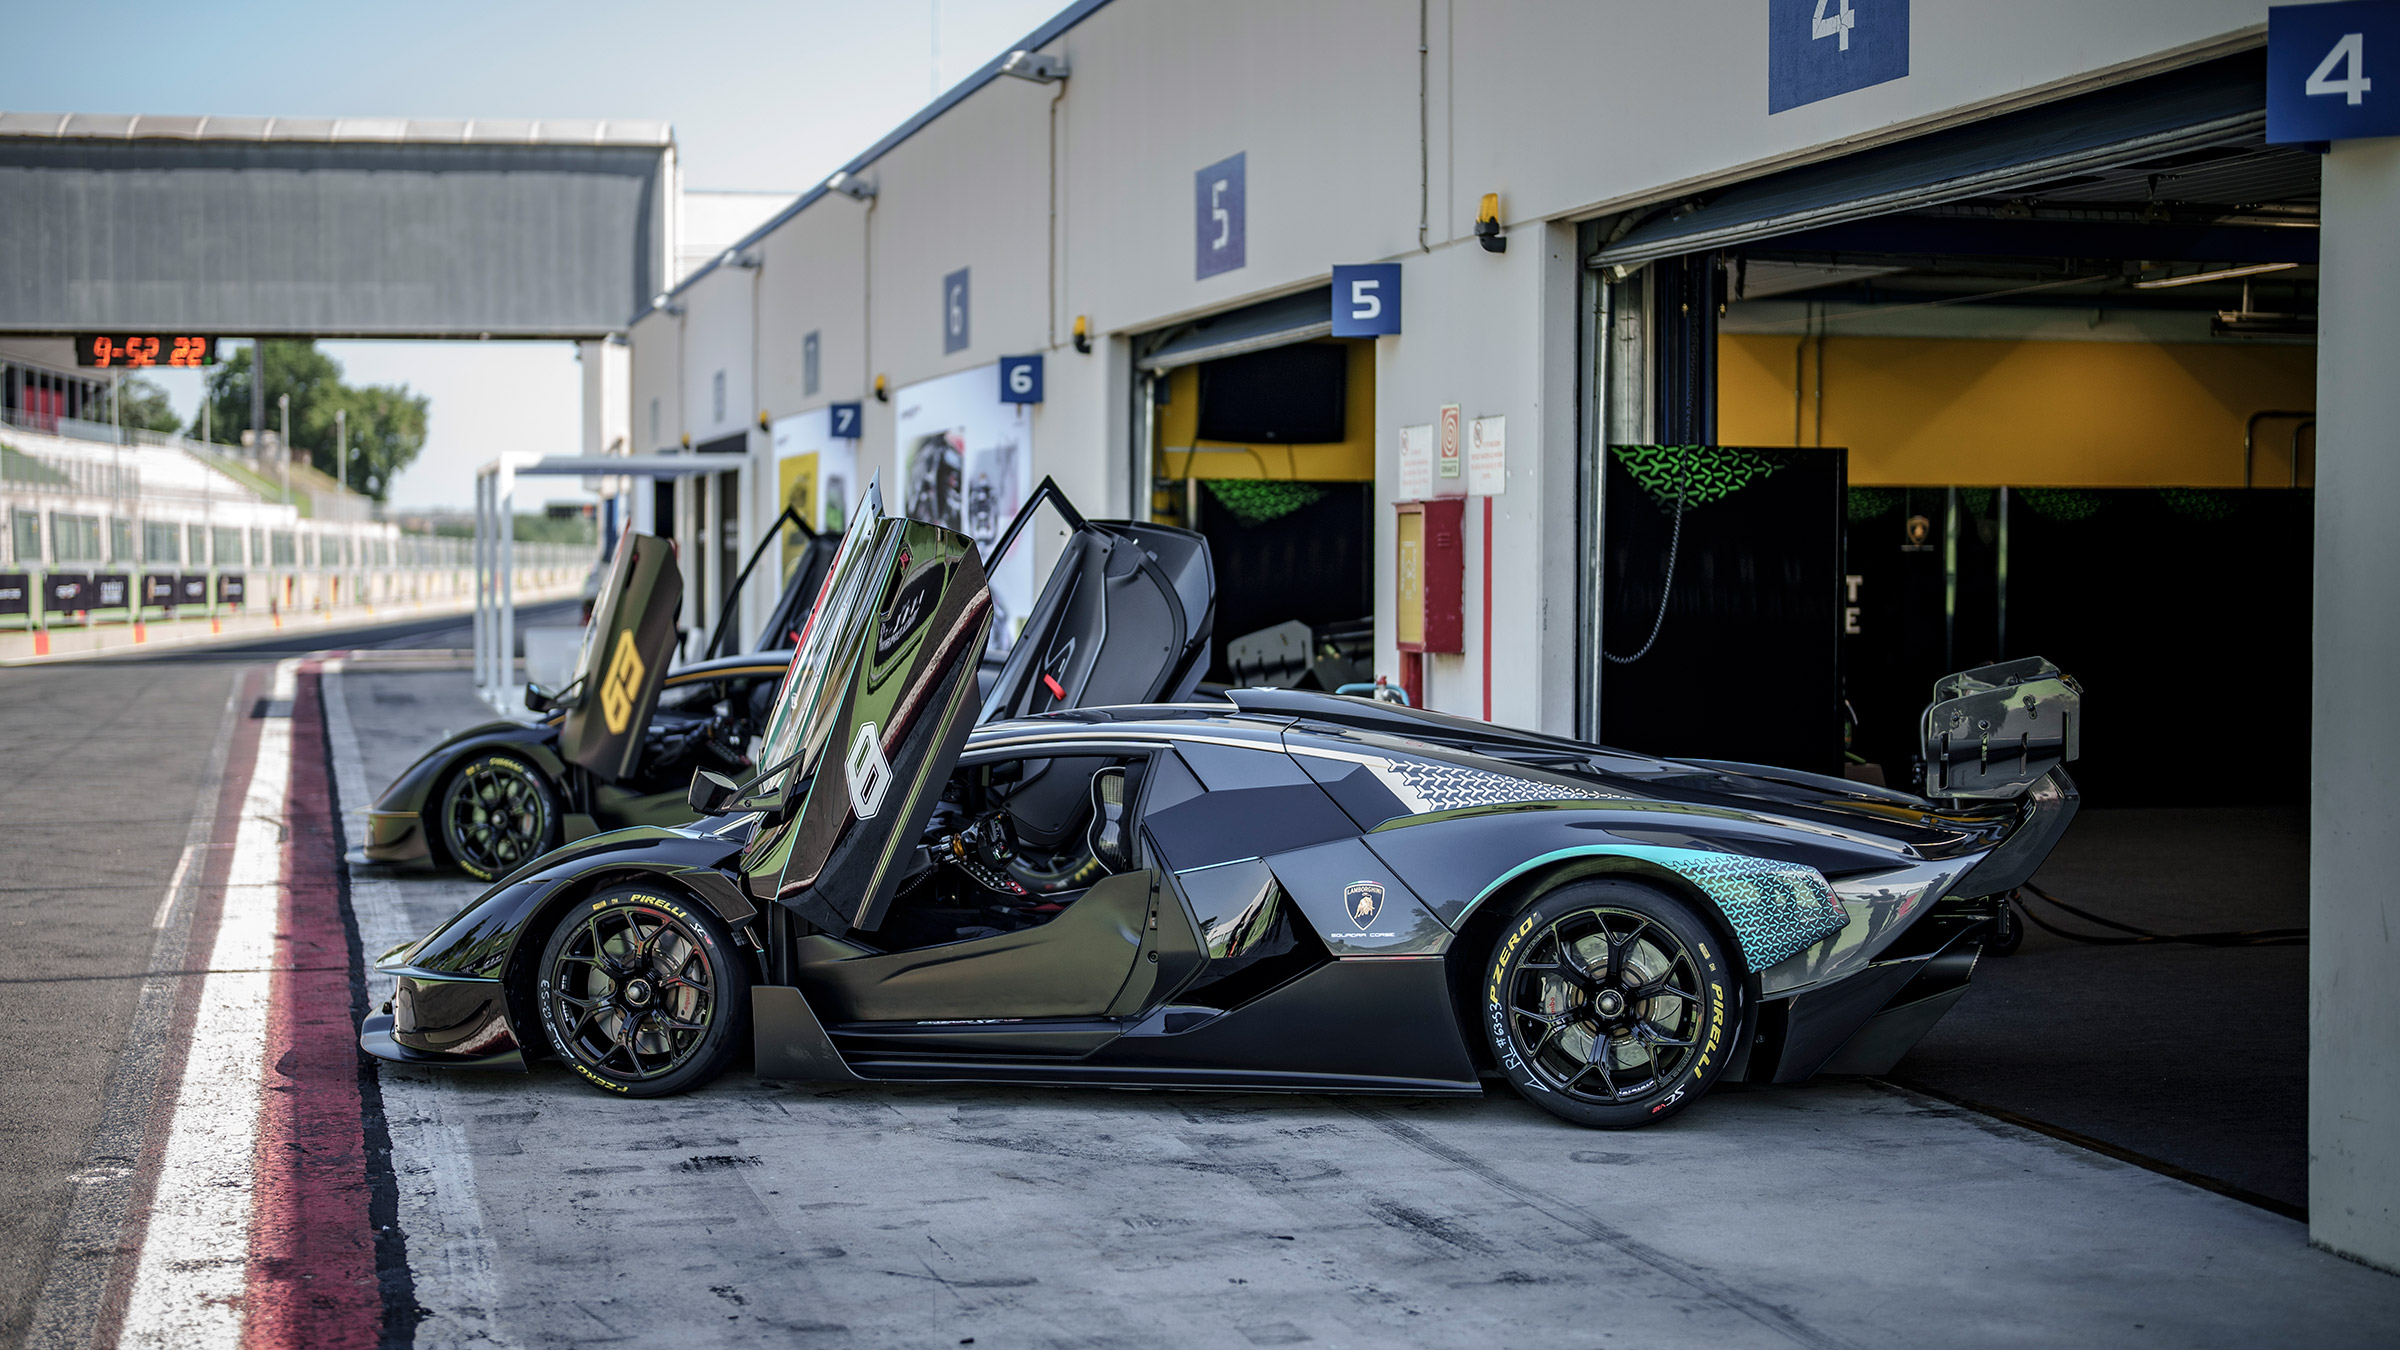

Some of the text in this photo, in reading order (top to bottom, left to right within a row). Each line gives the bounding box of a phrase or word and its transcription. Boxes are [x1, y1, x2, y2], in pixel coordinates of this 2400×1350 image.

[2306, 33, 2371, 105] 4
[1212, 179, 1229, 250] 5
[950, 284, 963, 336] 6
[1352, 280, 1381, 319] 5
[168, 336, 206, 368] 22
[1009, 365, 1033, 394] 6
[836, 409, 855, 432] 7
[631, 894, 687, 918] PIRELLI
[1347, 886, 1382, 895] LAMBORGHINI
[1694, 983, 1724, 1079] PIRELLI
